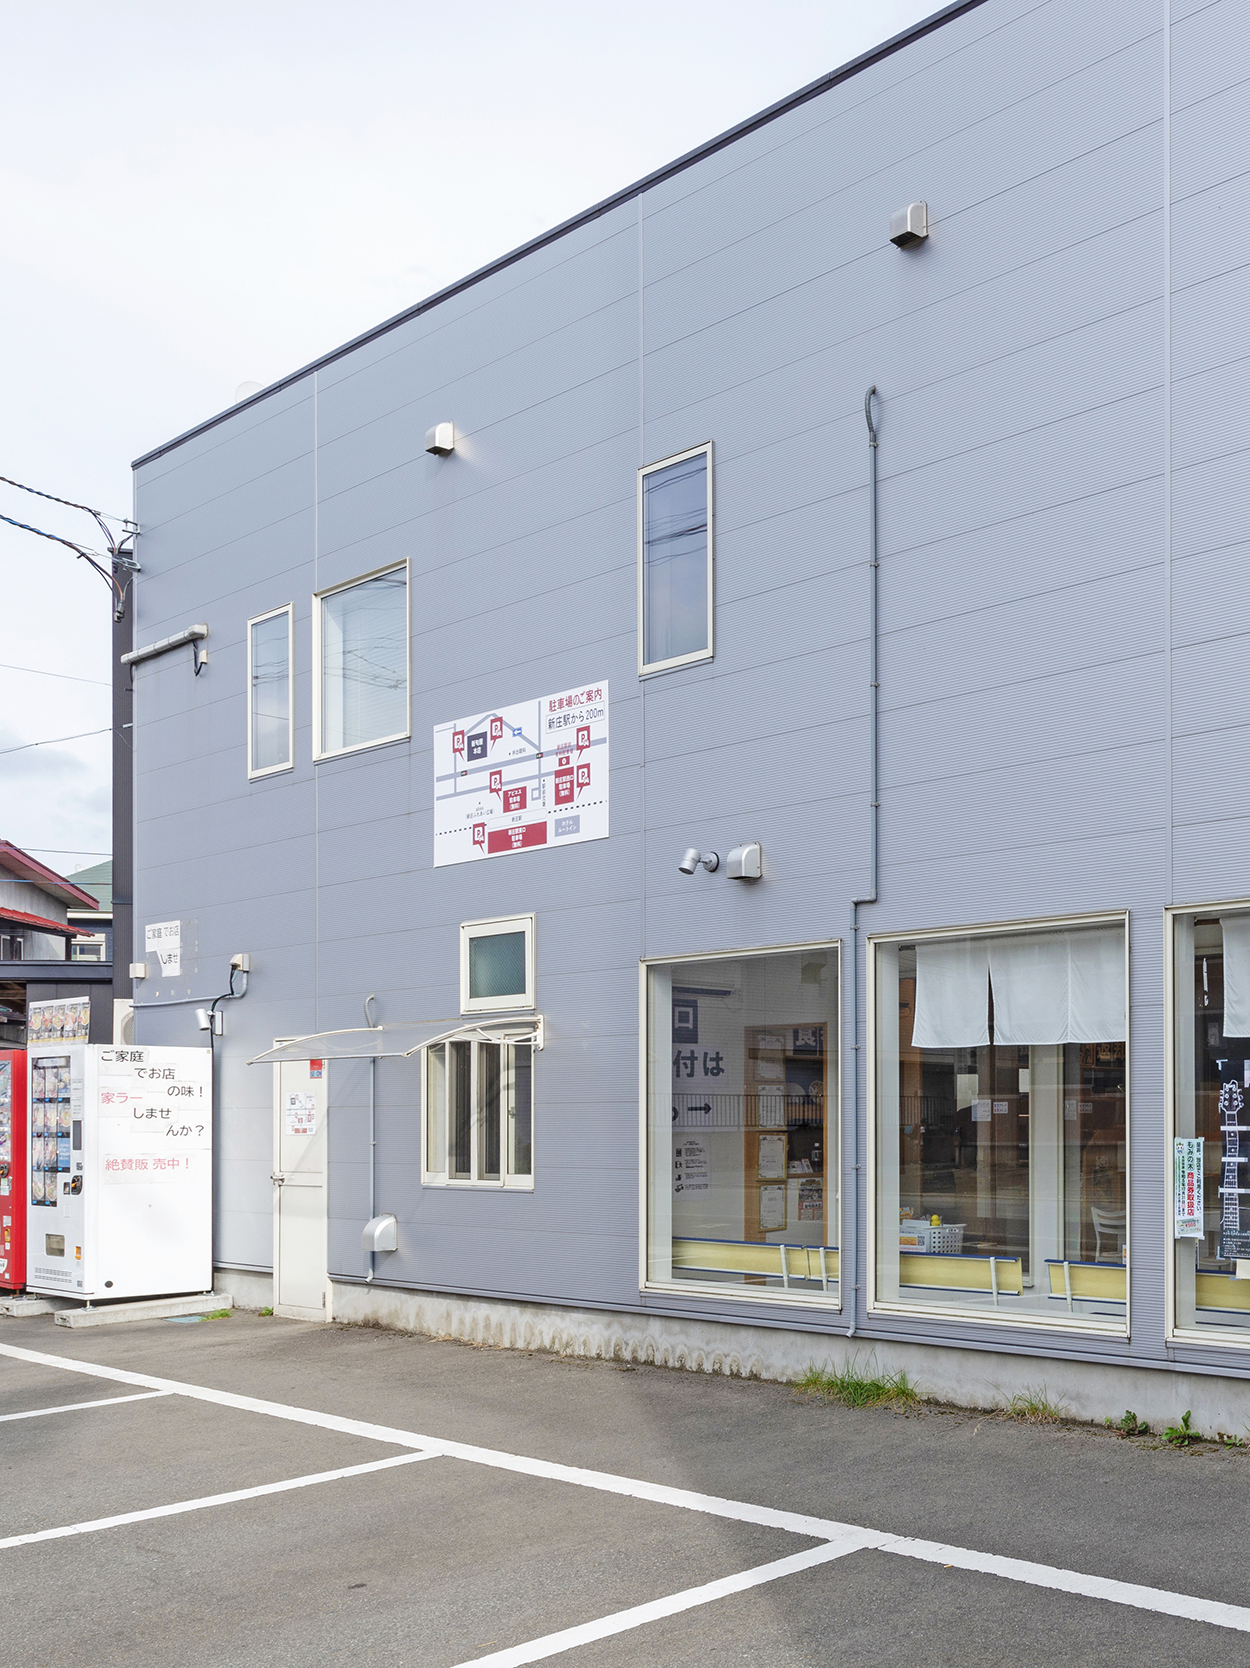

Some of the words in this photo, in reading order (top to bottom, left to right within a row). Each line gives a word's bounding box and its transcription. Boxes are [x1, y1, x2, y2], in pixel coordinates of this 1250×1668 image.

[549, 687, 602, 712] 駐車場のご案内
[101, 1050, 145, 1063] ご家庭
[134, 1067, 176, 1080] でお店
[101, 1092, 143, 1104] 家ラー
[133, 1107, 172, 1120] しませ
